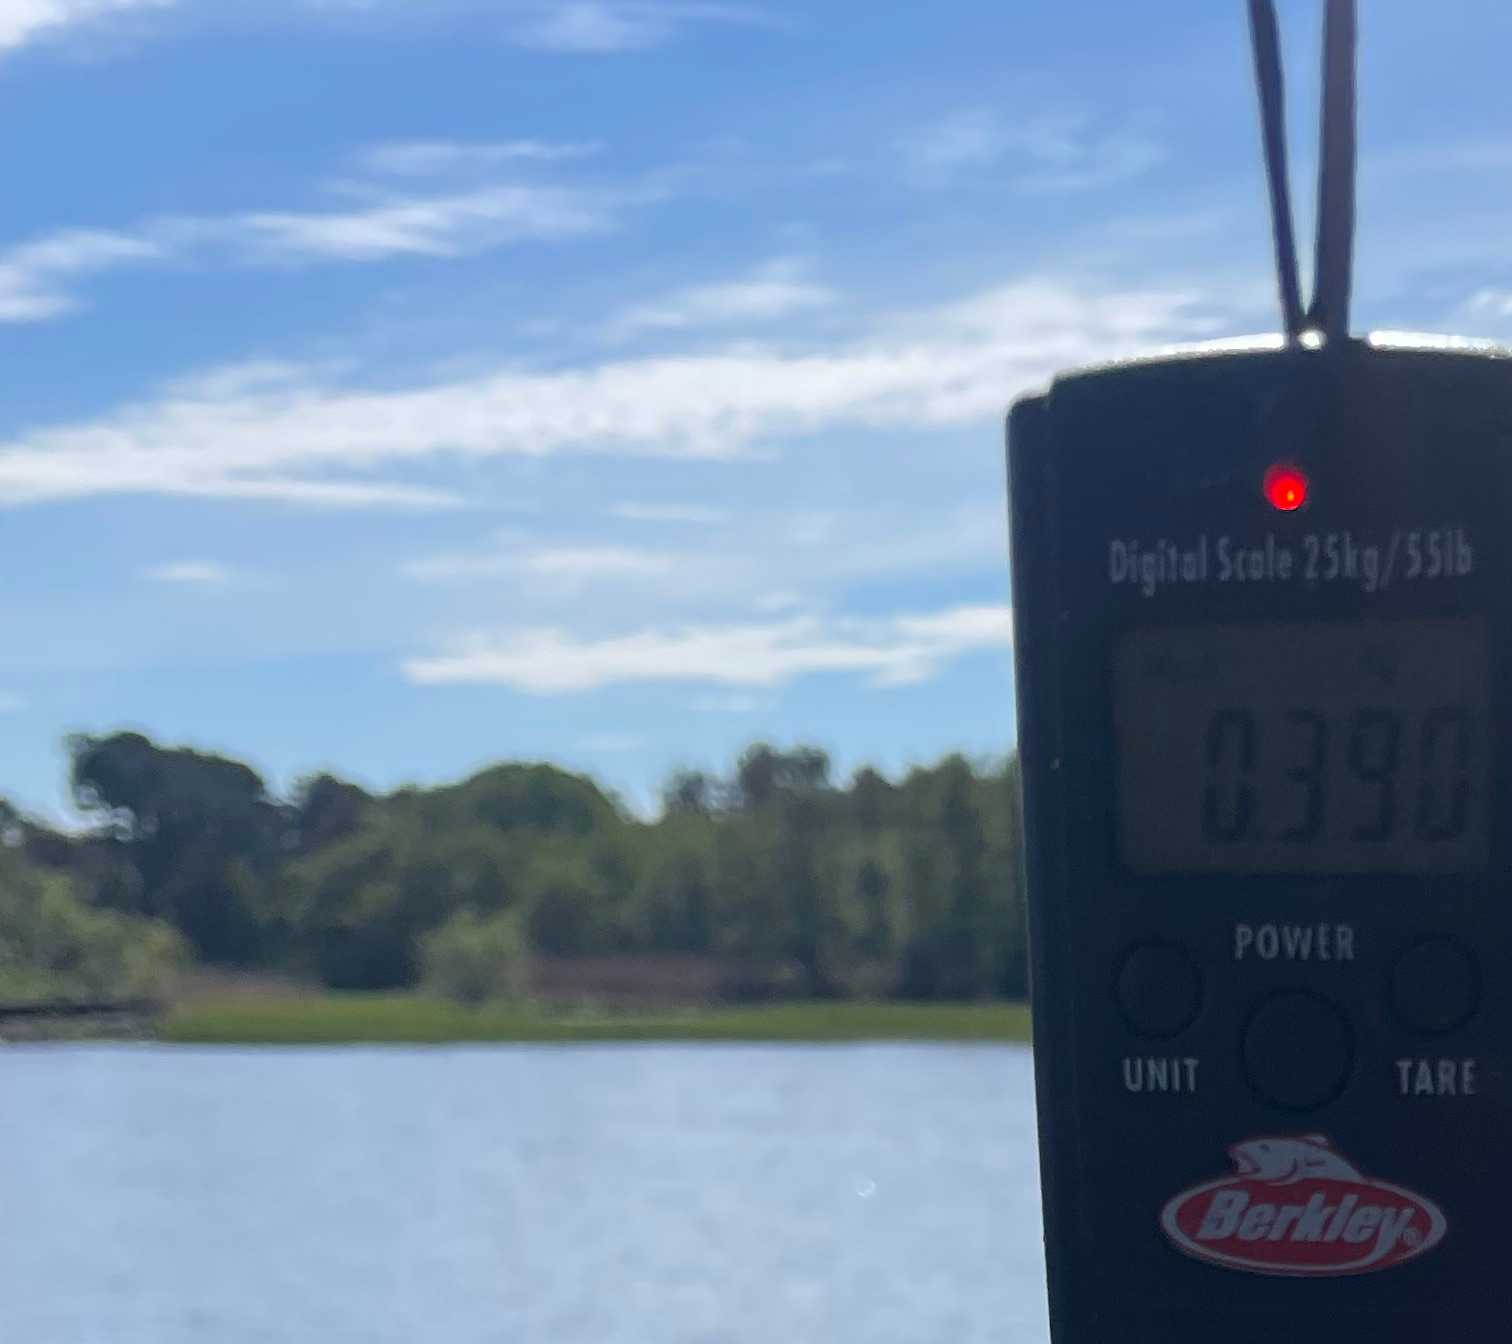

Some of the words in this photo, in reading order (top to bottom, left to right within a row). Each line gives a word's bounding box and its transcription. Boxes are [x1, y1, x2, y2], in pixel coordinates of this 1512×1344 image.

[1108, 534, 1208, 598] Digital
[1217, 531, 1295, 582] Scale
[1234, 922, 1355, 961] POWER
[1121, 1057, 1200, 1093] UNIT
[1394, 1057, 1477, 1096] TARE
